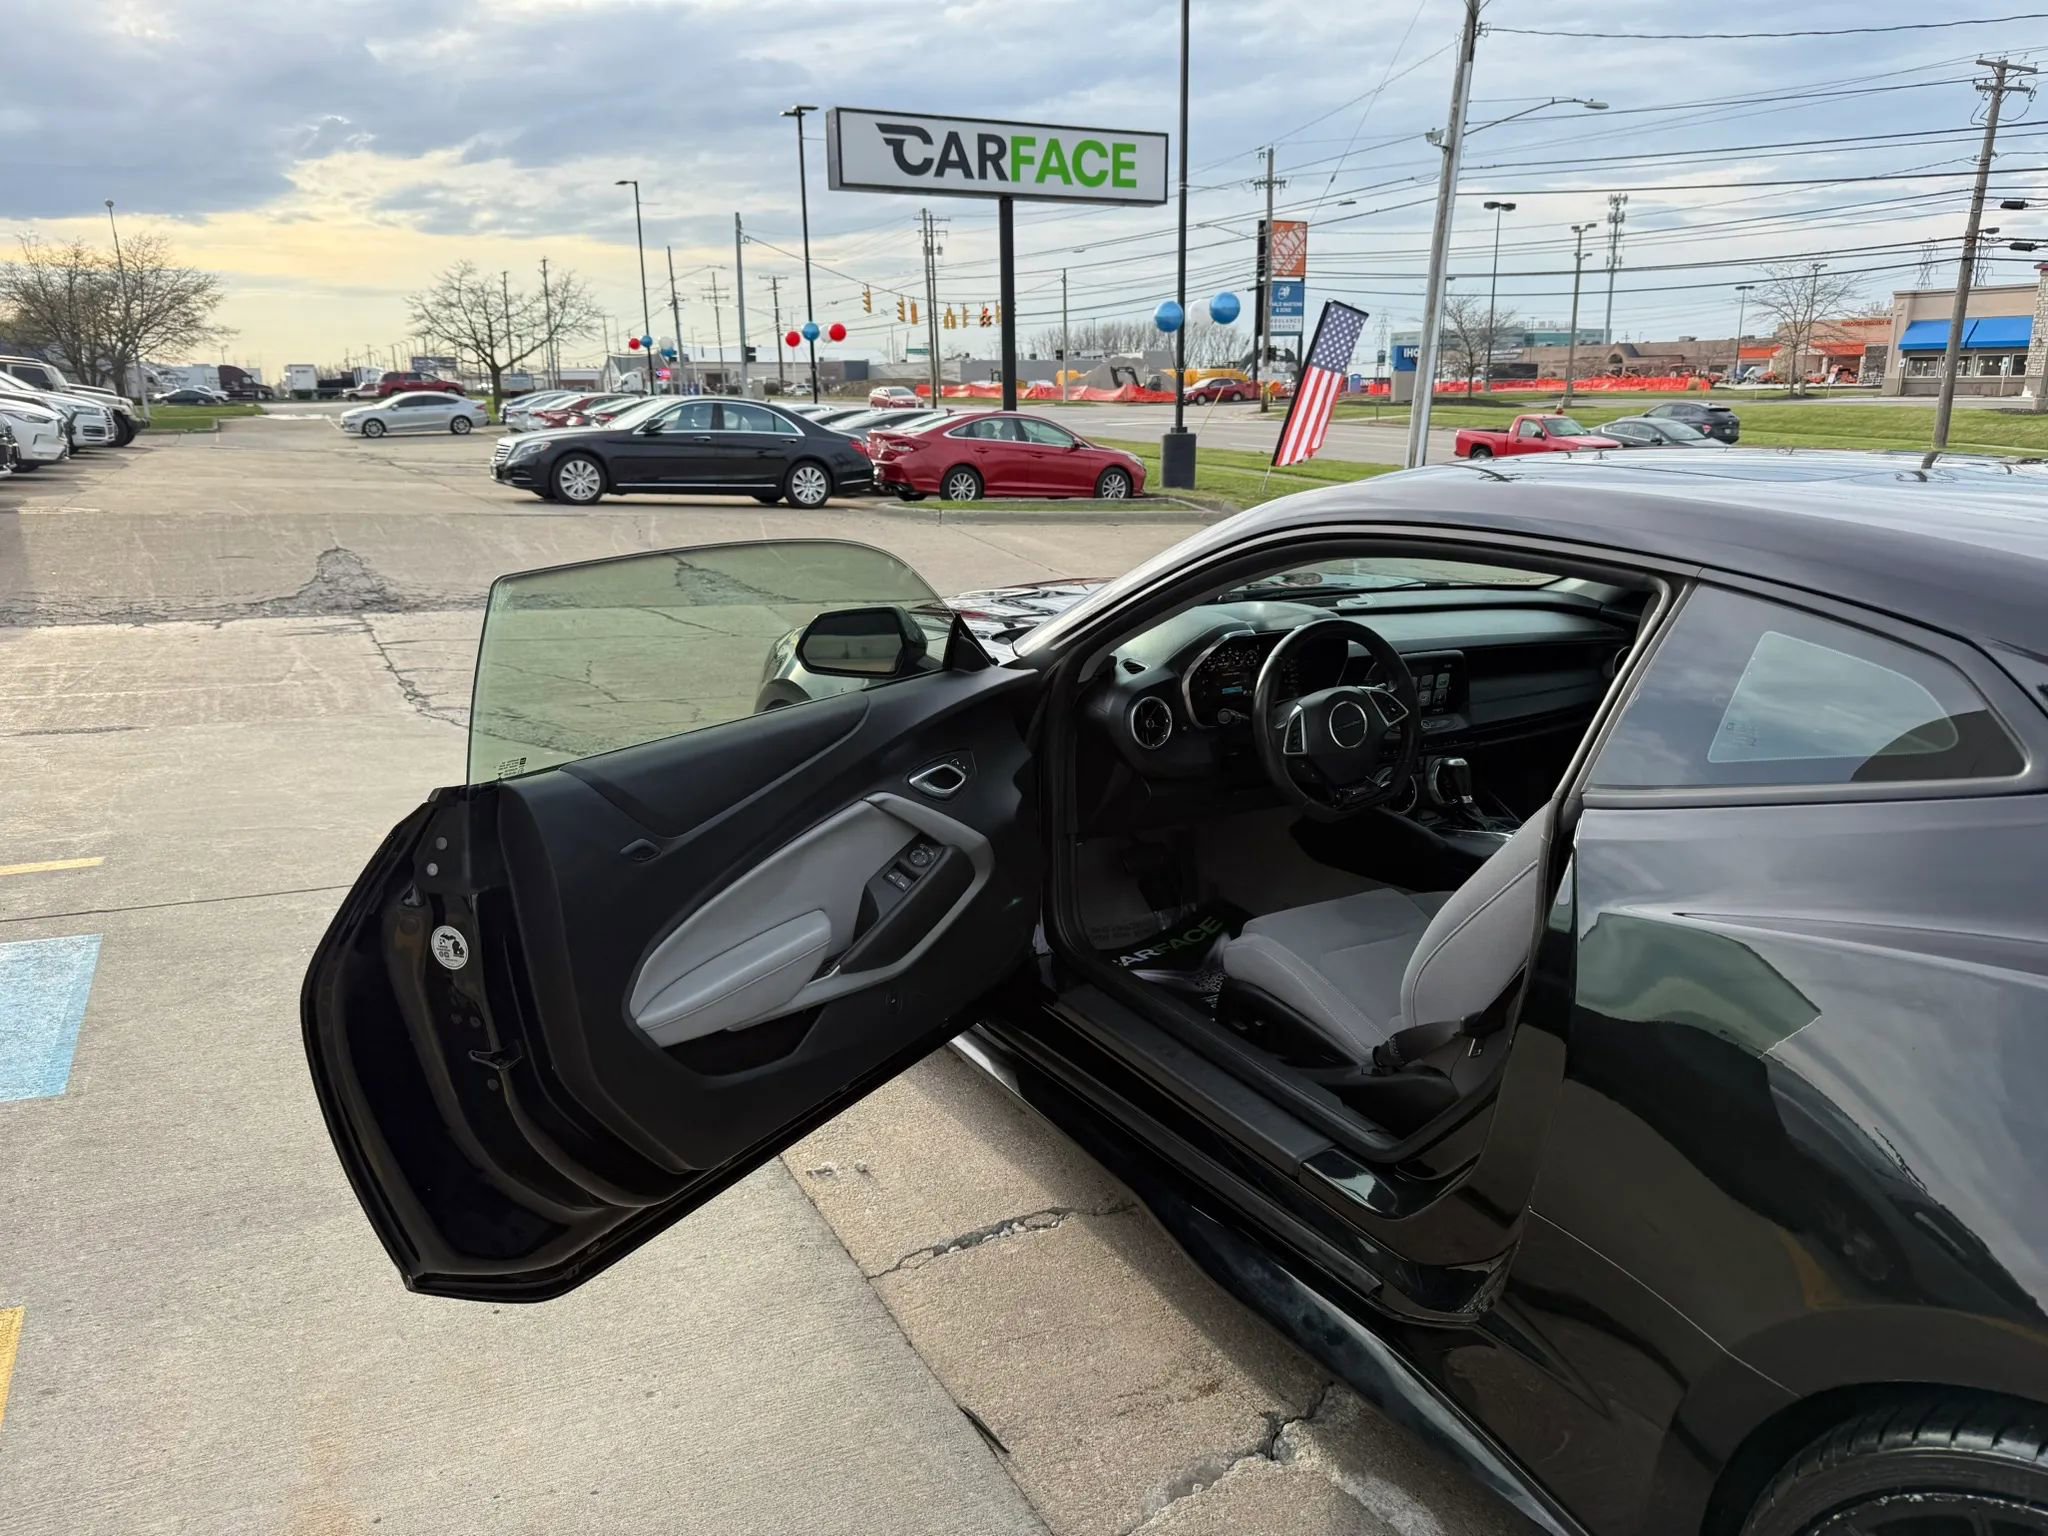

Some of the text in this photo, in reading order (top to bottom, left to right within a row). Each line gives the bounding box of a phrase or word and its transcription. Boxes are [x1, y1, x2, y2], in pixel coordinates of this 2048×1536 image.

[876, 123, 1137, 189] CARFACE
[1403, 347, 1421, 358] IHO
[1112, 915, 1224, 967] ARFACE
